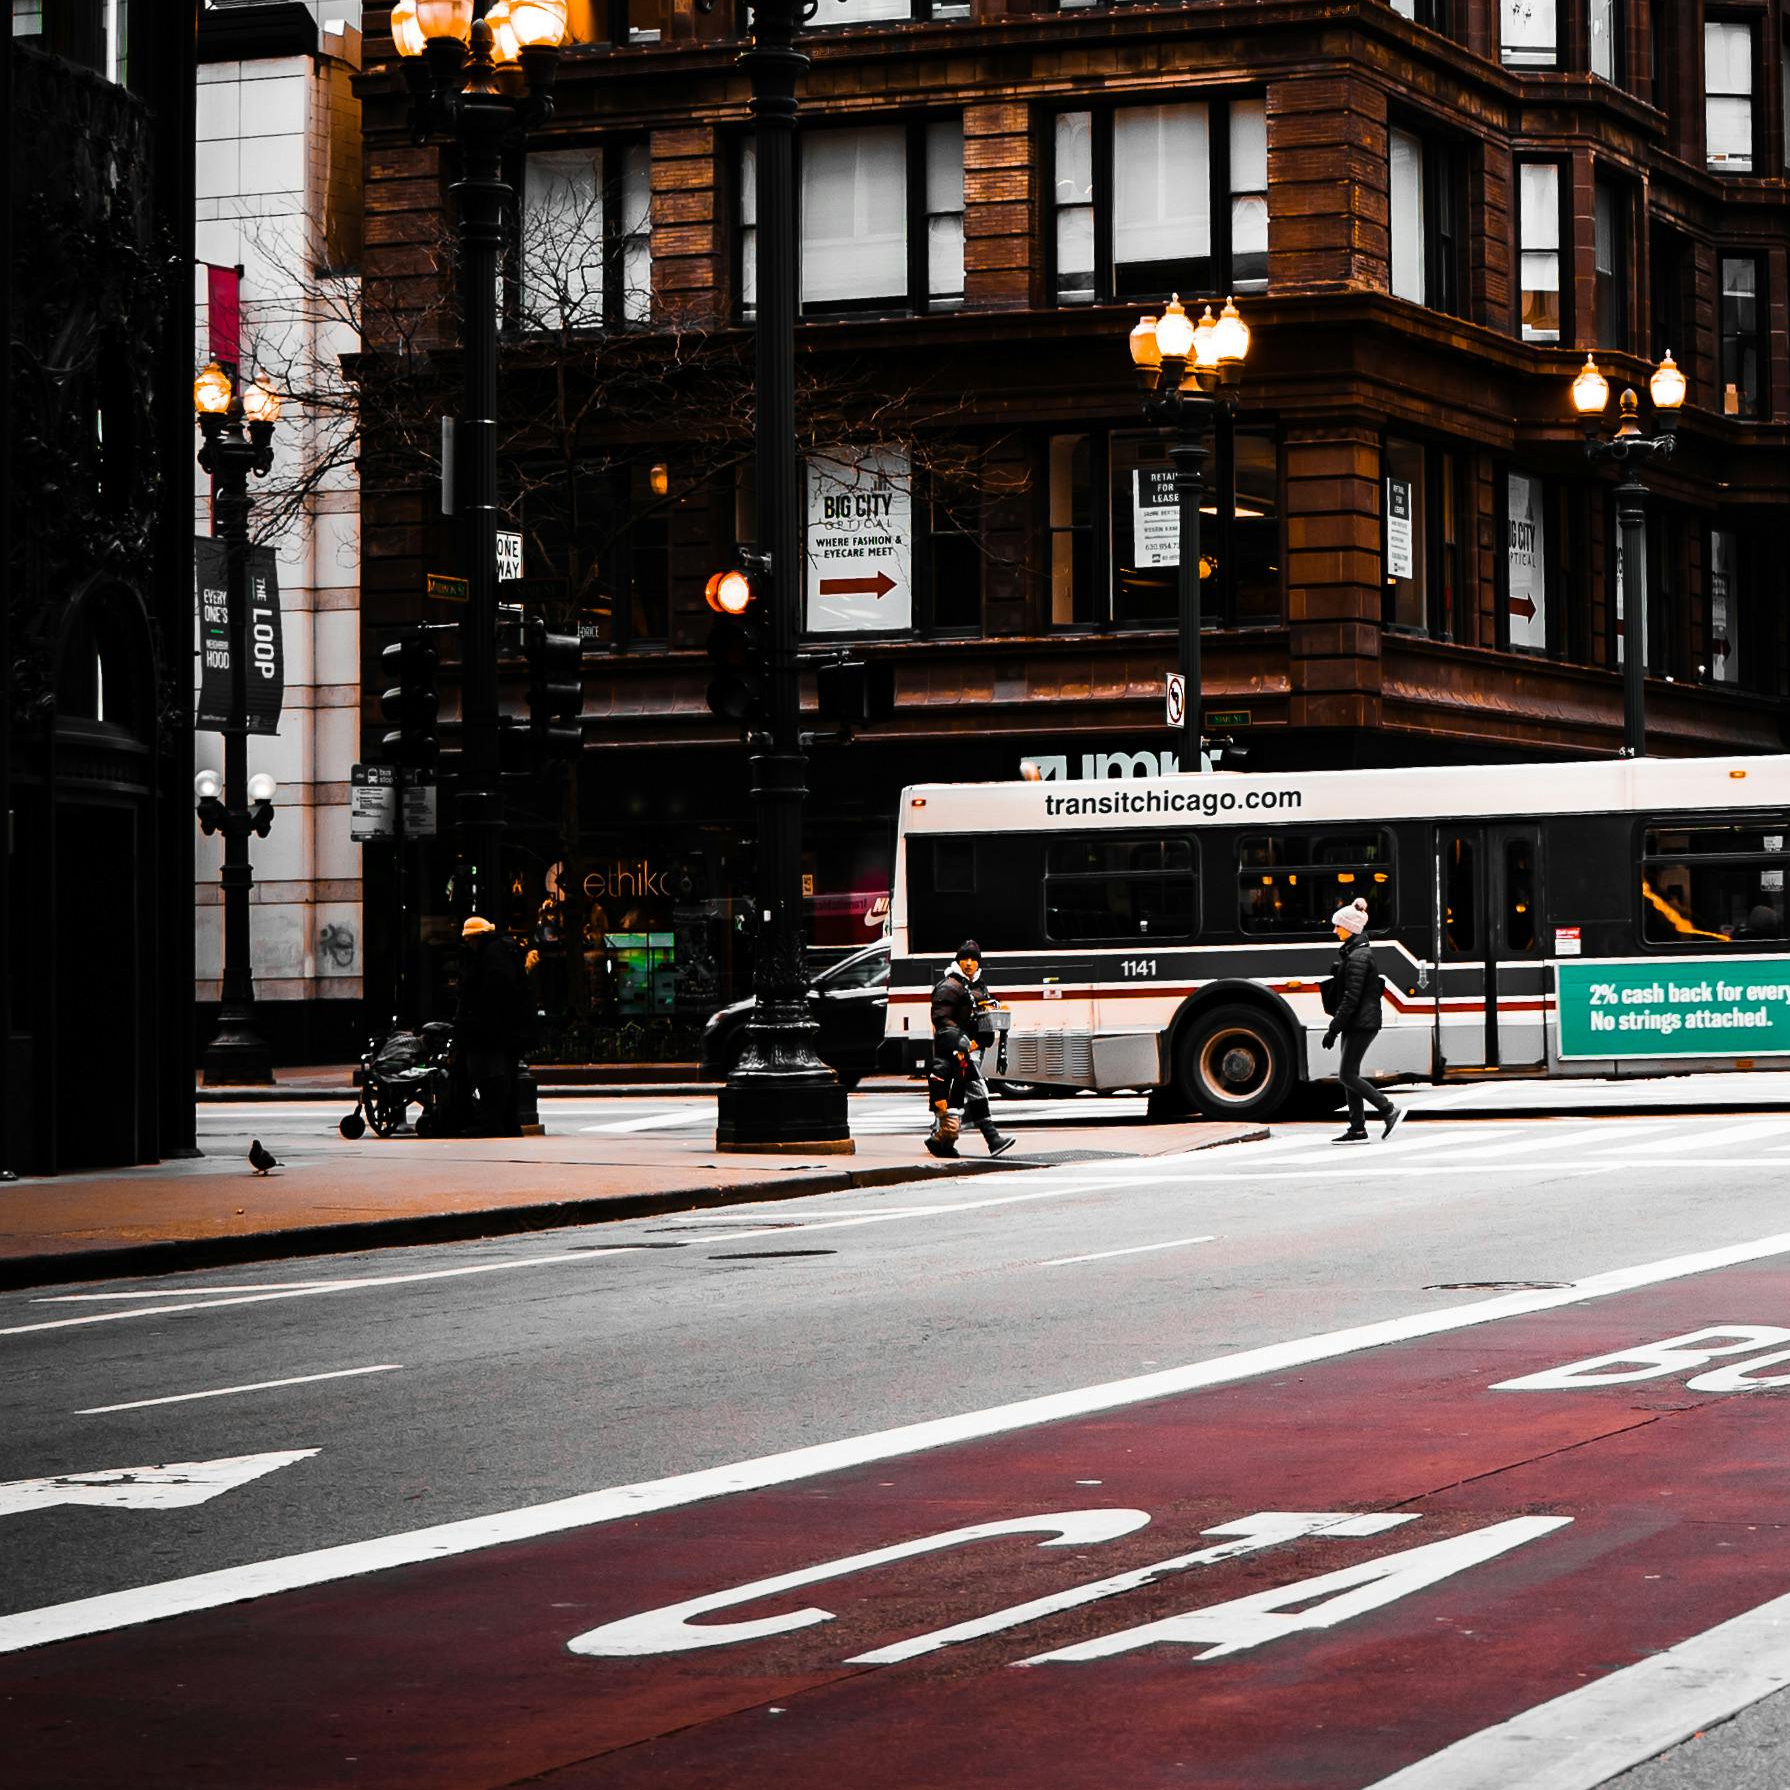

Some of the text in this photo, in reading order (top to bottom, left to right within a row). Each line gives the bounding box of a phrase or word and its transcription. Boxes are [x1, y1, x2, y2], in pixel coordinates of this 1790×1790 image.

[1151, 472, 1179, 482] RETAI
[1157, 483, 1174, 492] FOR
[824, 493, 893, 519] BIG CITY
[1152, 493, 1179, 503] LEASE
[825, 519, 893, 530] OPTICAL
[816, 535, 902, 548] WHERE FASHION &
[1509, 519, 1536, 553] IG CITY
[497, 538, 519, 558] ONE
[824, 546, 894, 559] EYECARE MEET
[1509, 552, 1536, 569] PTICAL
[203, 588, 228, 606] EVERY
[255, 577, 267, 602] THE
[204, 605, 229, 624] ONE'S
[252, 608, 275, 680] LOOP
[206, 650, 230, 669] HOOD
[1046, 789, 1302, 817] transitchicago.com
[1121, 960, 1157, 977] 1141
[1589, 983, 1619, 1006] 2%
[1621, 983, 1663, 1005] cash
[1668, 981, 1712, 1004] back
[1716, 980, 1742, 1002] for
[1590, 1006, 1773, 1034] No strings attached.
[566, 1507, 1576, 1668] CTA
